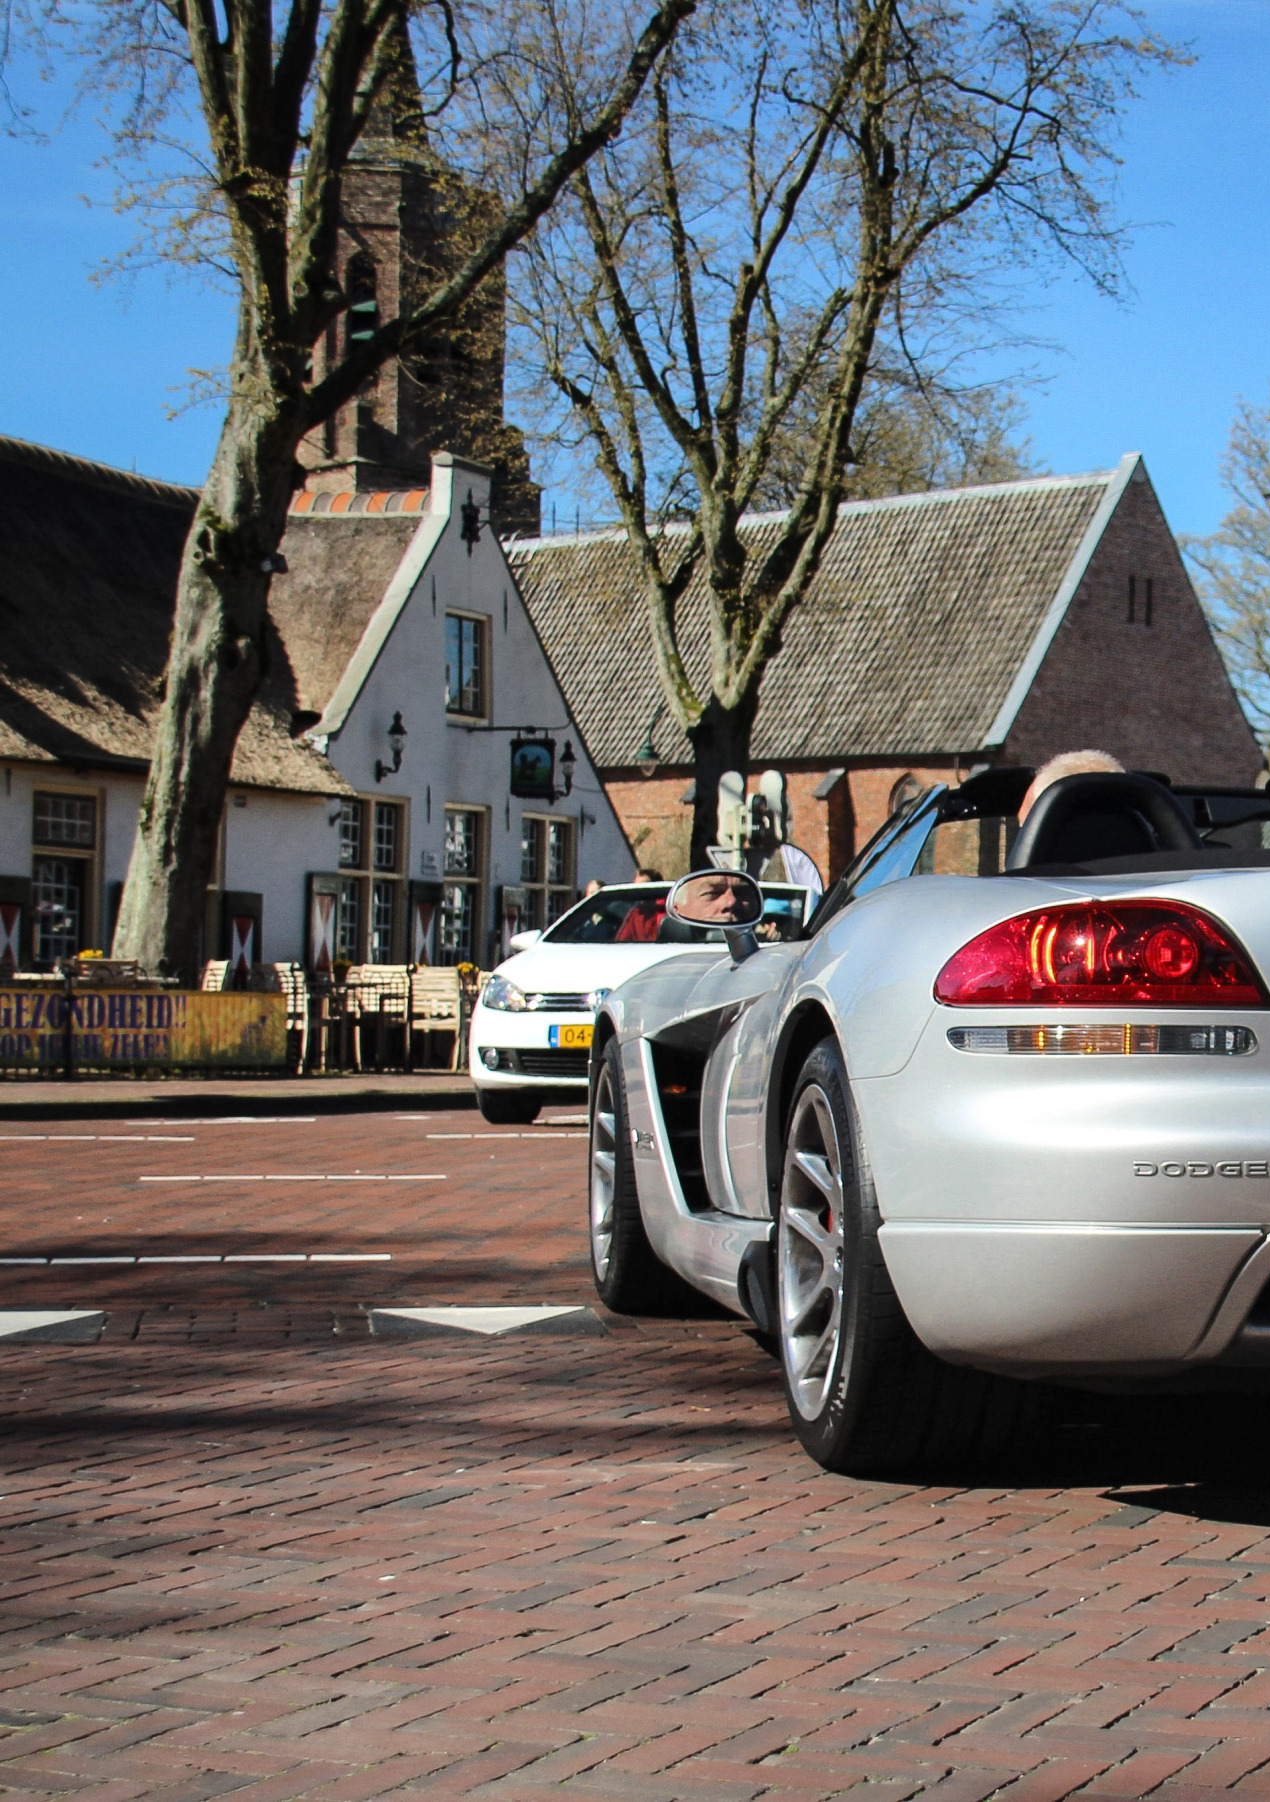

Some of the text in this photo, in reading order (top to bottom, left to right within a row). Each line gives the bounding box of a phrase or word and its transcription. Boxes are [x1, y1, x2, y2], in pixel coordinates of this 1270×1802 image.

[0, 992, 188, 1030] GEZONDHEID!!
[1, 1033, 32, 1060] OP
[1132, 1160, 1270, 1179] DODGE
